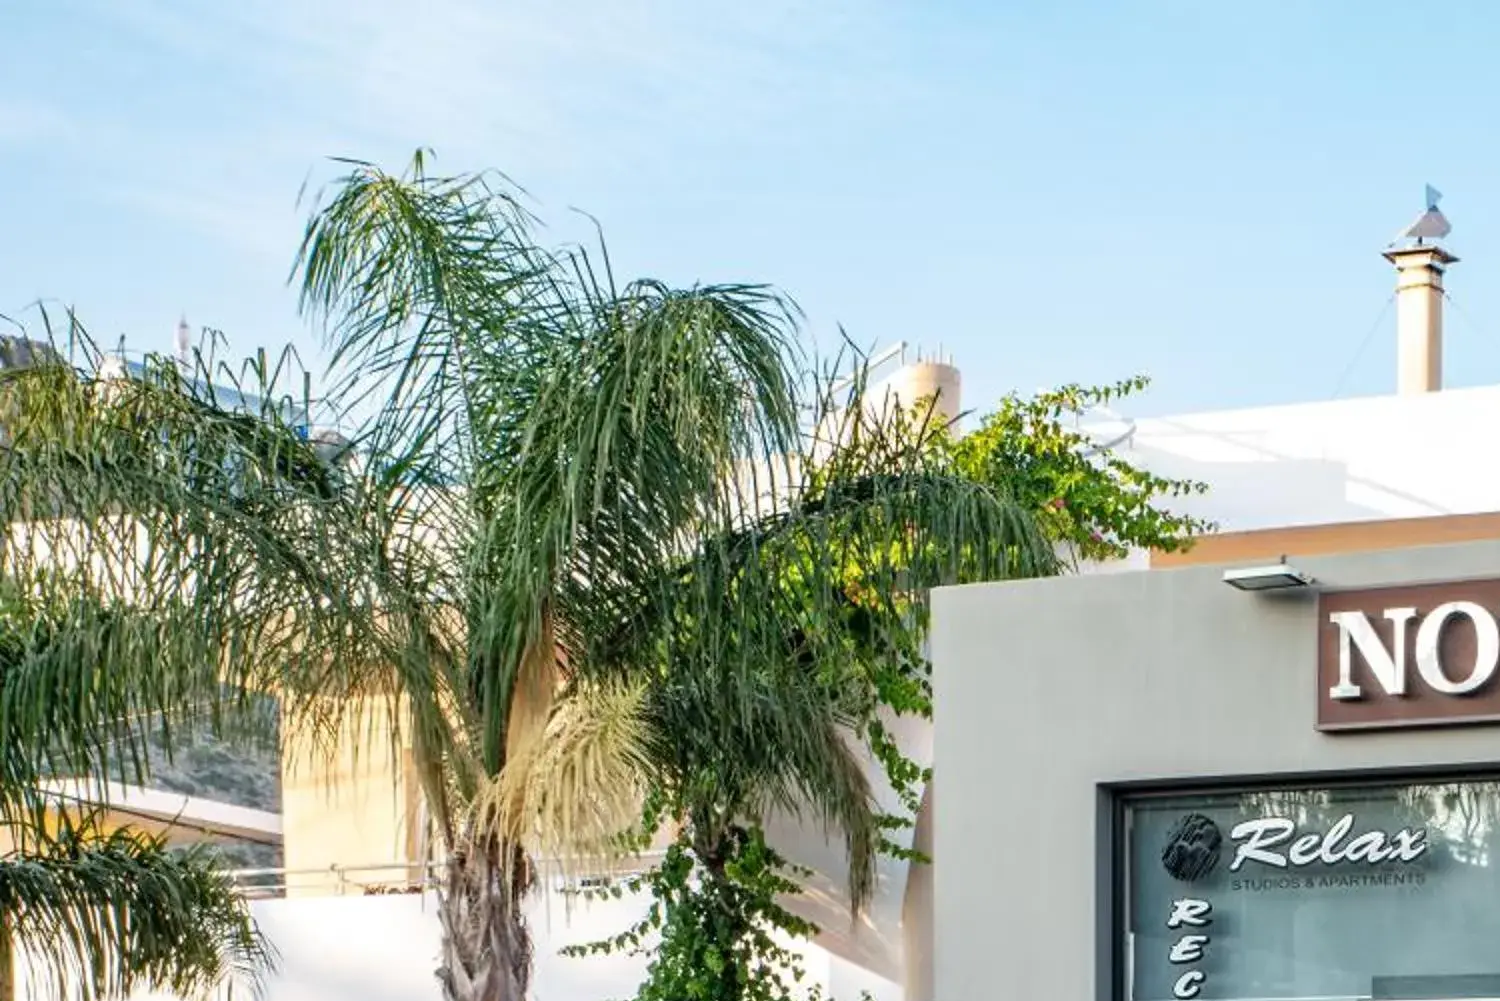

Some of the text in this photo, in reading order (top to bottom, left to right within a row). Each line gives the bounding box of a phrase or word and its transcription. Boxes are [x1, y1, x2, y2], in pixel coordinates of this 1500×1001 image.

[1229, 813, 1427, 871] Relax
[1231, 878, 1301, 891] STUDIOS
[1318, 873, 1426, 888] APARTMENTS
